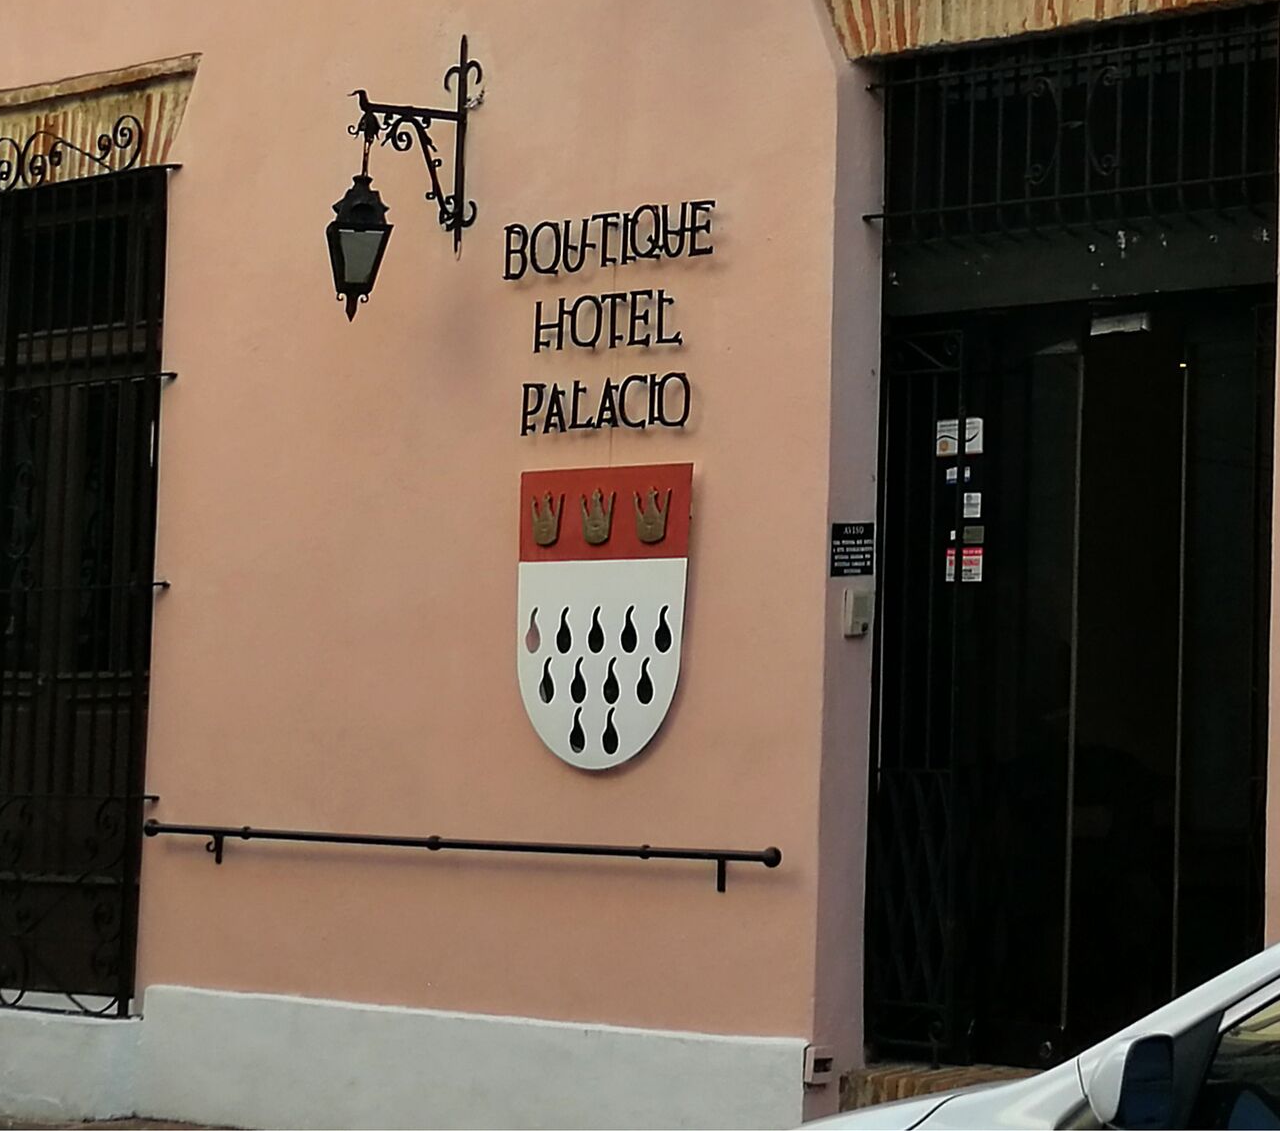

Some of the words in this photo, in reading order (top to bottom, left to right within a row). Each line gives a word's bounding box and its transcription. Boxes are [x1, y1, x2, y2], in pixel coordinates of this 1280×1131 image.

[502, 200, 716, 281] BOUTIQUE
[532, 288, 683, 354] HOTEL
[520, 371, 691, 437] PALACIO
